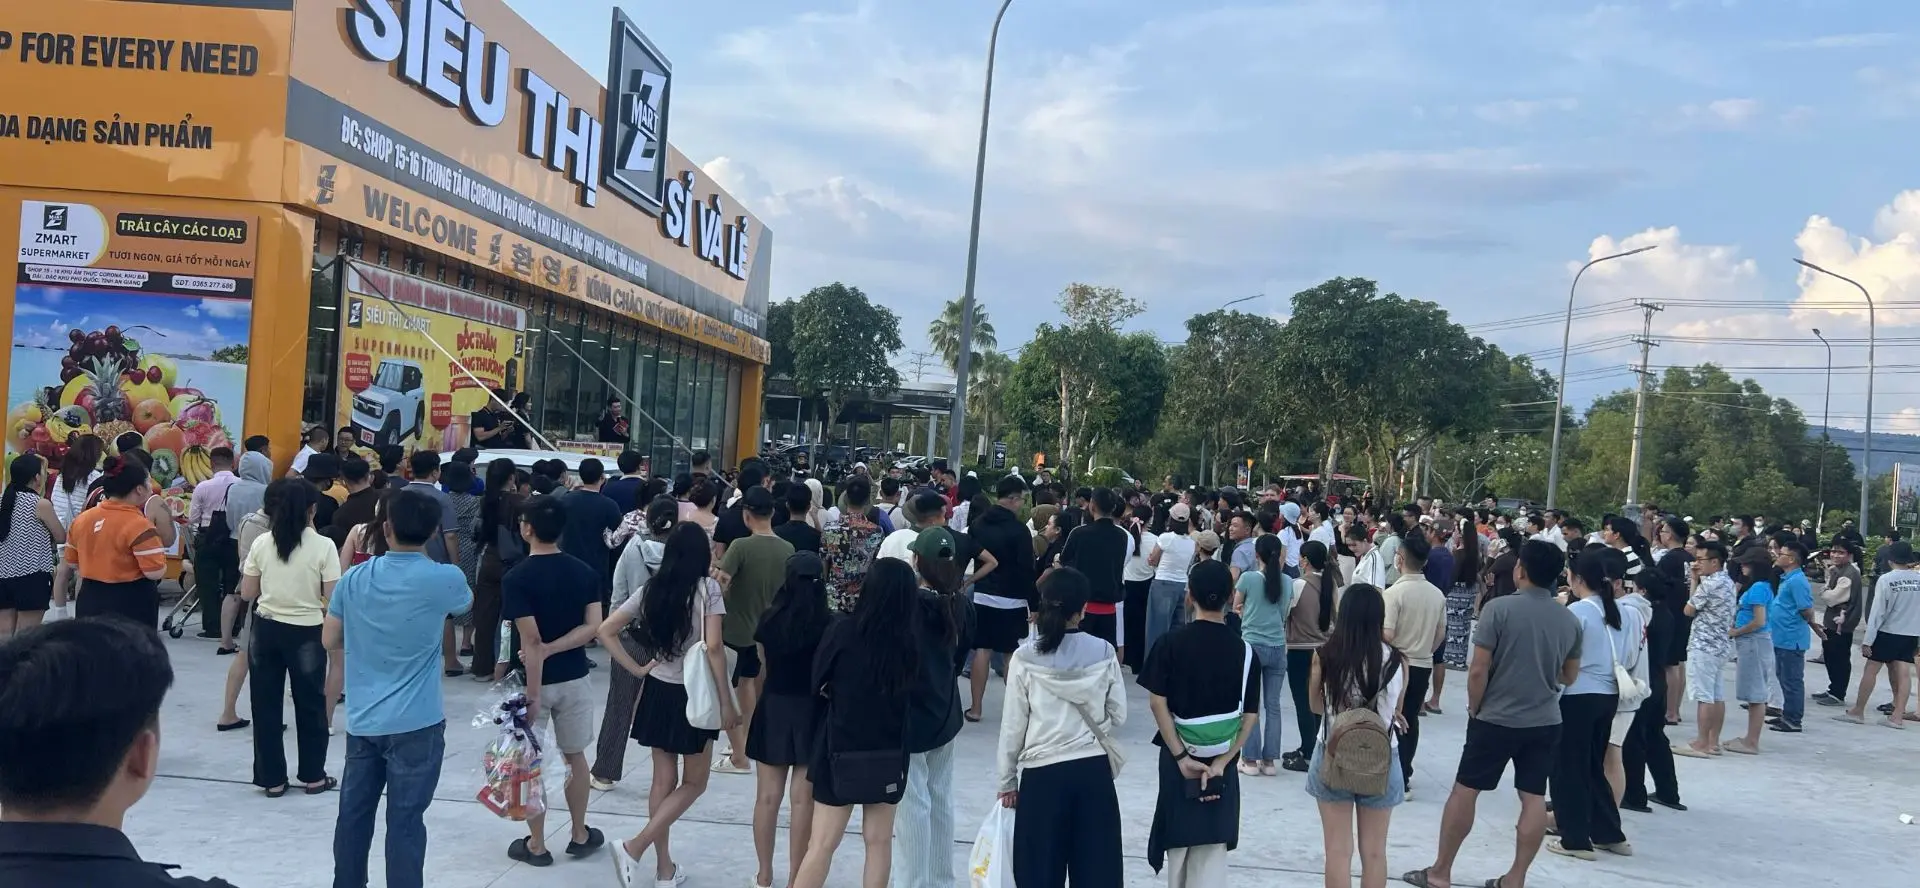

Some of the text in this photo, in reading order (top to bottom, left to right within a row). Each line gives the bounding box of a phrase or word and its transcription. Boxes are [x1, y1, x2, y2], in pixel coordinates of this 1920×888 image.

[20, 32, 75, 65] FOR
[81, 35, 175, 71] EVERY
[180, 41, 259, 76] NEED
[27, 115, 87, 145] DẠNG
[93, 113, 139, 146] SẢN
[145, 113, 213, 150] PHẨM
[631, 94, 659, 134] MART
[525, 69, 602, 207] THỊ
[341, 114, 362, 150] ĐC:
[363, 126, 392, 163] SHOP
[394, 143, 420, 177] 15-16
[421, 155, 452, 192] TRUNG
[452, 168, 470, 199] TÂM
[470, 180, 502, 215] CORONA
[502, 195, 518, 222] PHÚ
[537, 211, 551, 237] KHU
[120, 218, 242, 240] TRÁI CÂY CÁC LOẠI
[363, 184, 478, 255] WELCOME
[667, 171, 695, 247] SỈ
[700, 194, 724, 267] VÀ
[21, 247, 90, 260] SUPERMARKET
[35, 233, 77, 245] ZMART
[165, 253, 182, 263] GIÁ
[185, 253, 202, 265] TỐT
[225, 258, 251, 268] NGÀY
[586, 274, 612, 305] KÍNH
[613, 288, 643, 313] CHÀO
[365, 305, 385, 325] SIÊU
[355, 337, 435, 360] SUPERMARKET
